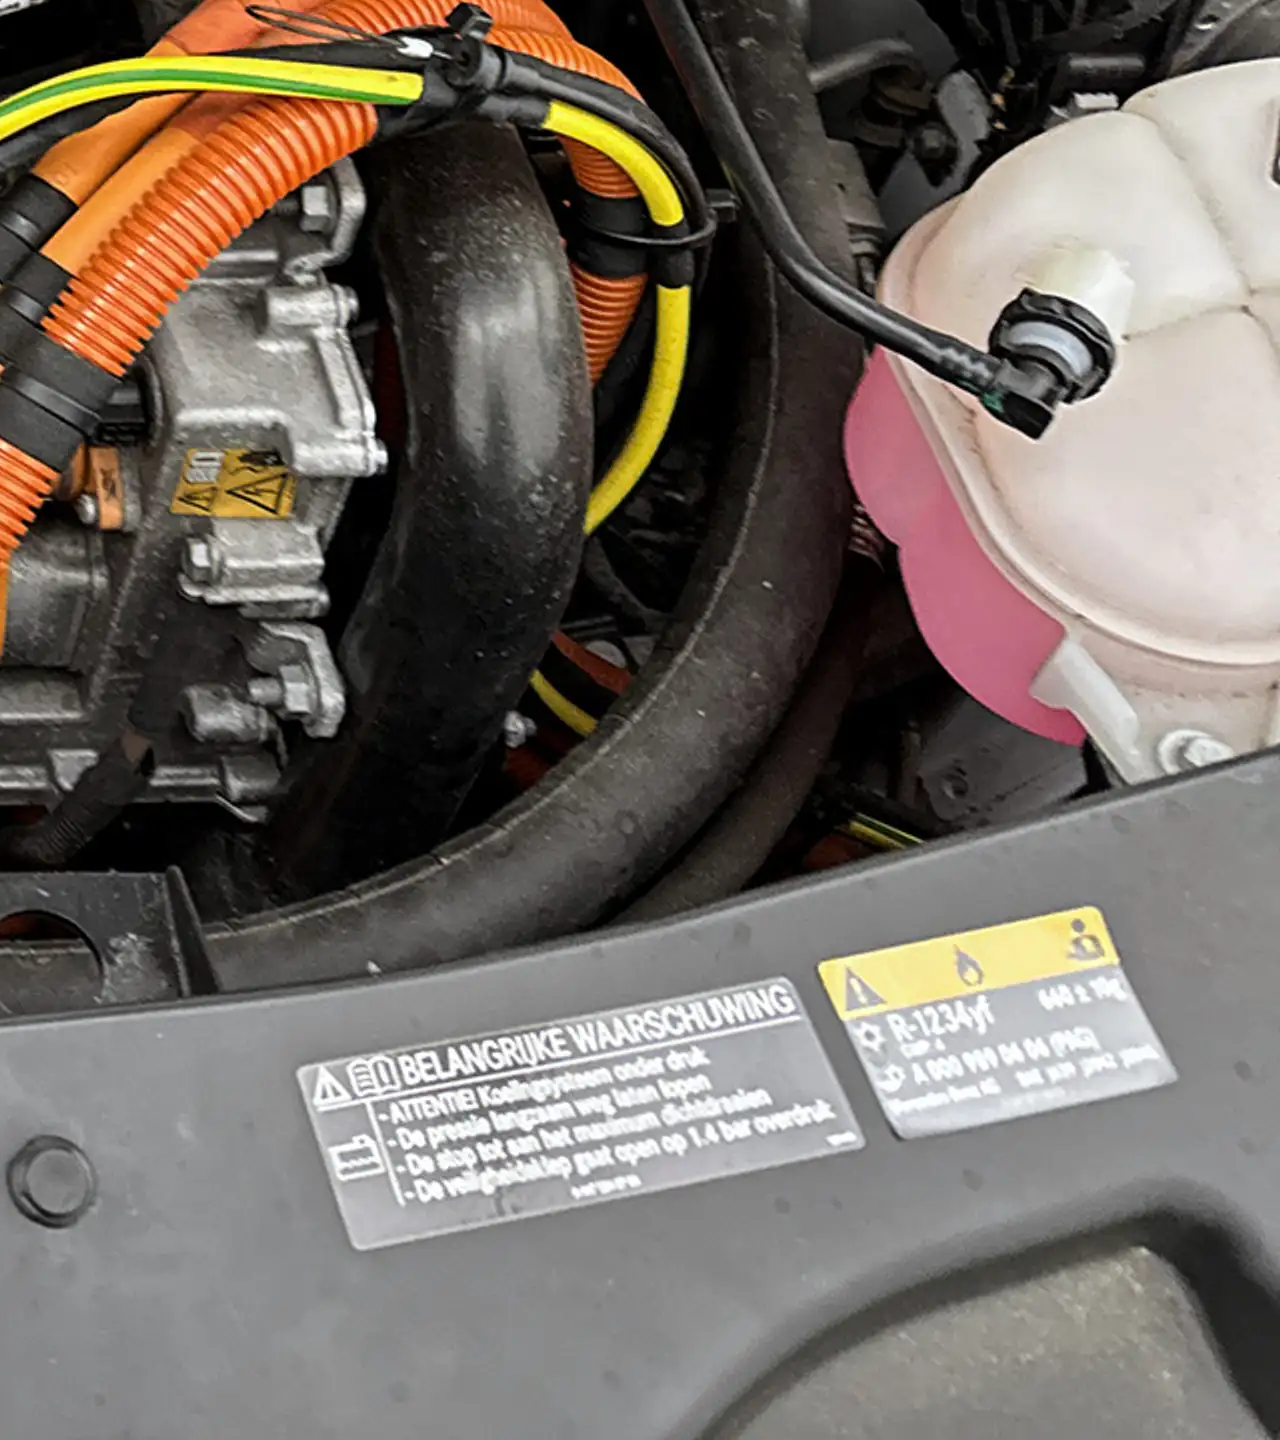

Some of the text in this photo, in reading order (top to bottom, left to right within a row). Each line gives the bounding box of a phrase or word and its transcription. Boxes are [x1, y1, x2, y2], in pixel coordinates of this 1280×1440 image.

[886, 994, 995, 1043] R-1234yf
[399, 984, 797, 1086] BELANGRIJKE WAARSCHUWING
[389, 1088, 480, 1125] ATTENTIE!
[396, 1126, 426, 1150] De
[406, 1154, 436, 1176] De
[414, 1179, 444, 1203] De
